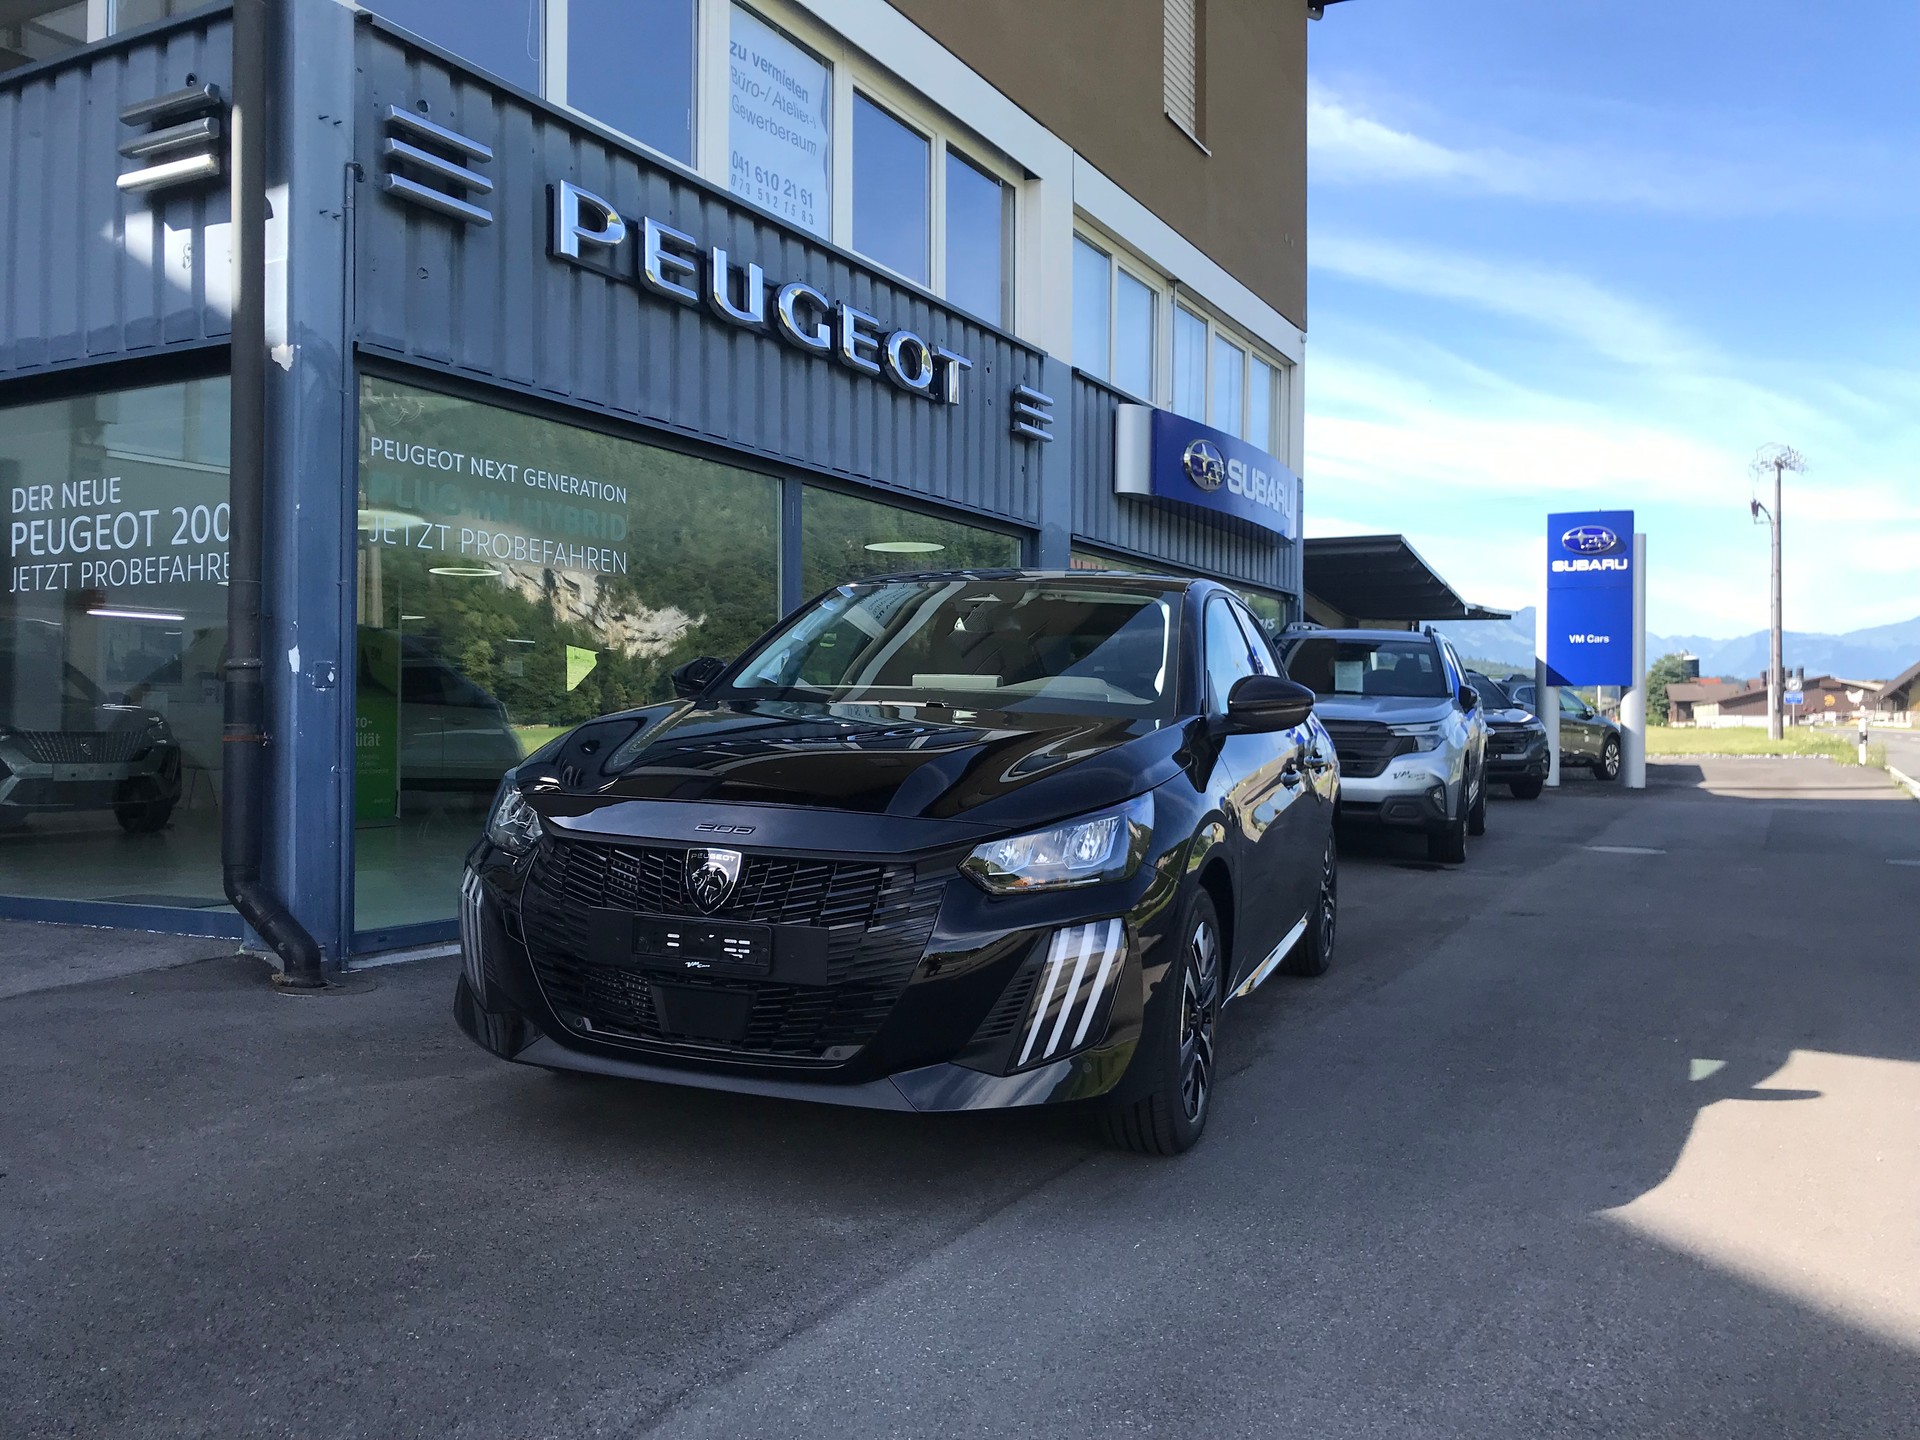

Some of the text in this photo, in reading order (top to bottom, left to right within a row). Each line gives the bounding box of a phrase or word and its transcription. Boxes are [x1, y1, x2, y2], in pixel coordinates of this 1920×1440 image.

[730, 41, 809, 104] zu vermieten
[732, 94, 817, 156] Gewerberaum
[732, 150, 813, 209] 041 610 21 61
[553, 178, 972, 405] PEUGEOT
[12, 476, 121, 513] DER NEUE
[370, 437, 627, 504] PEUGEOT NEXT GENERATION
[1227, 458, 1292, 519] SUBARU
[11, 509, 160, 557] PEUGEOT
[369, 516, 627, 575] JETZT PROBEFAHREN
[9, 562, 73, 592] JETZT
[1552, 558, 1628, 572] SUBARU
[1569, 634, 1610, 643] VM Cars
[691, 853, 736, 862] PEUGEOT
